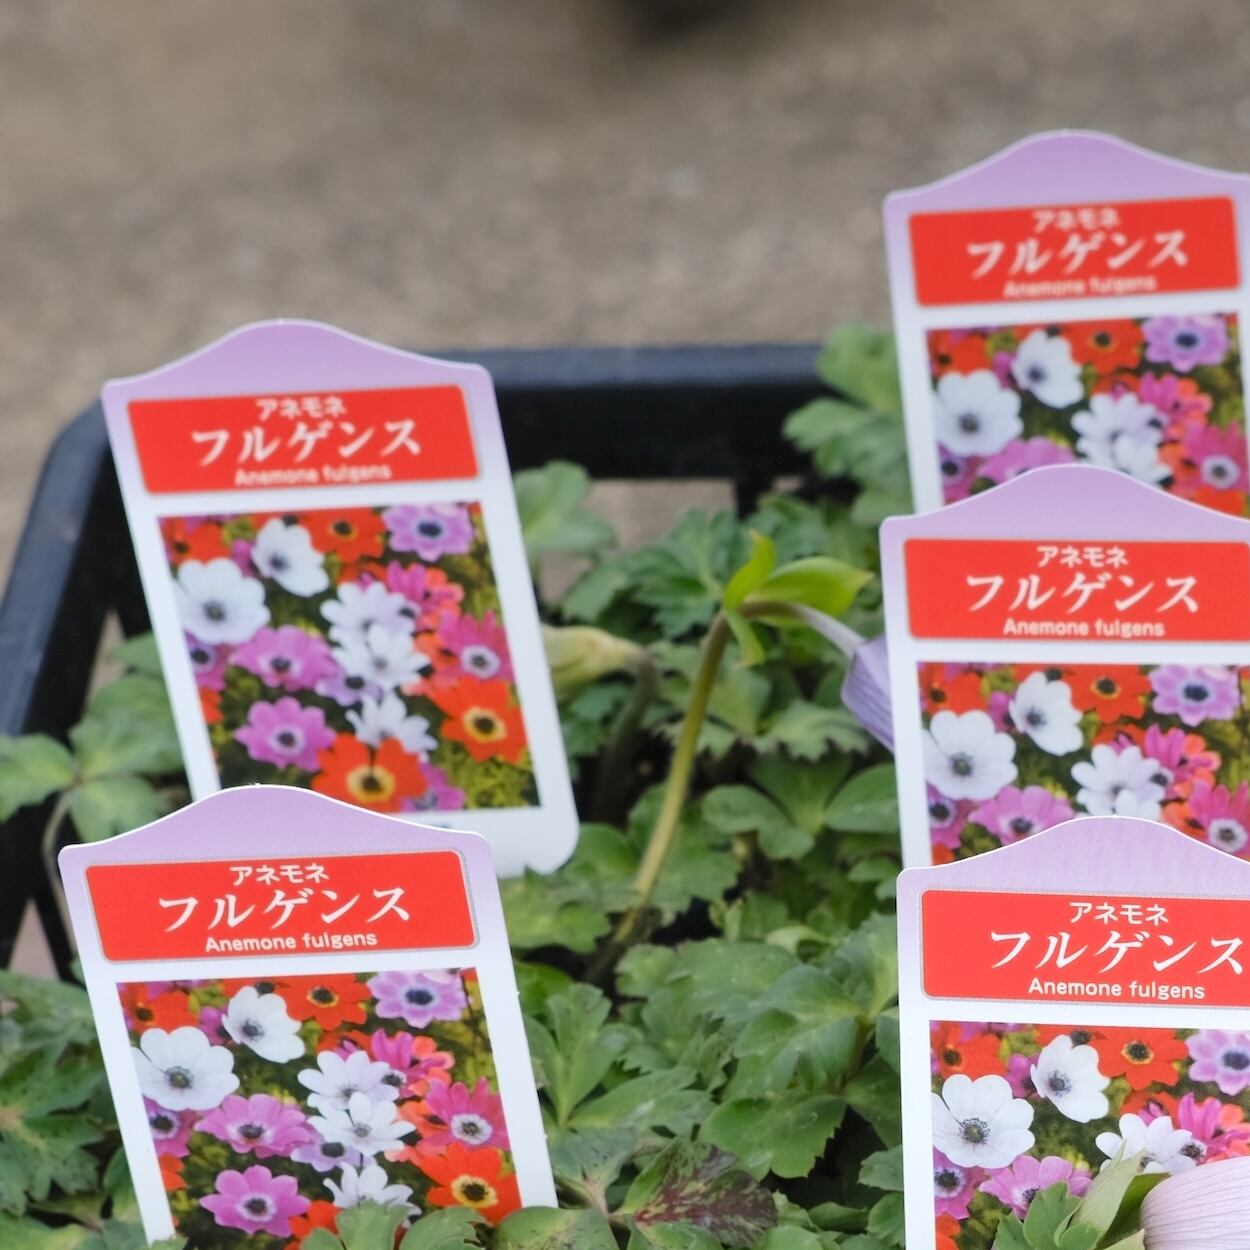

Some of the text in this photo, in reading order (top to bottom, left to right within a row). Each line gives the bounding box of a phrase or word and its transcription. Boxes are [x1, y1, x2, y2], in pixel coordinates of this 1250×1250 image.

[1034, 208, 1119, 232] アネモネ
[967, 230, 1188, 277] フルゲンス
[256, 395, 346, 420] アネモネ
[192, 419, 421, 465] フルゲンス
[1037, 545, 1128, 568] アネモネ
[967, 572, 1198, 613] フルゲンス
[1004, 618, 1165, 636] Anemone fulgens
[230, 863, 329, 886] アネモネ
[159, 887, 409, 931] フルゲンス
[1070, 902, 1168, 926] アネモネ
[206, 932, 378, 952] Anemone fulgens
[991, 931, 1243, 974] フルゲンス
[1028, 978, 1205, 1000] Anemone fulgens
